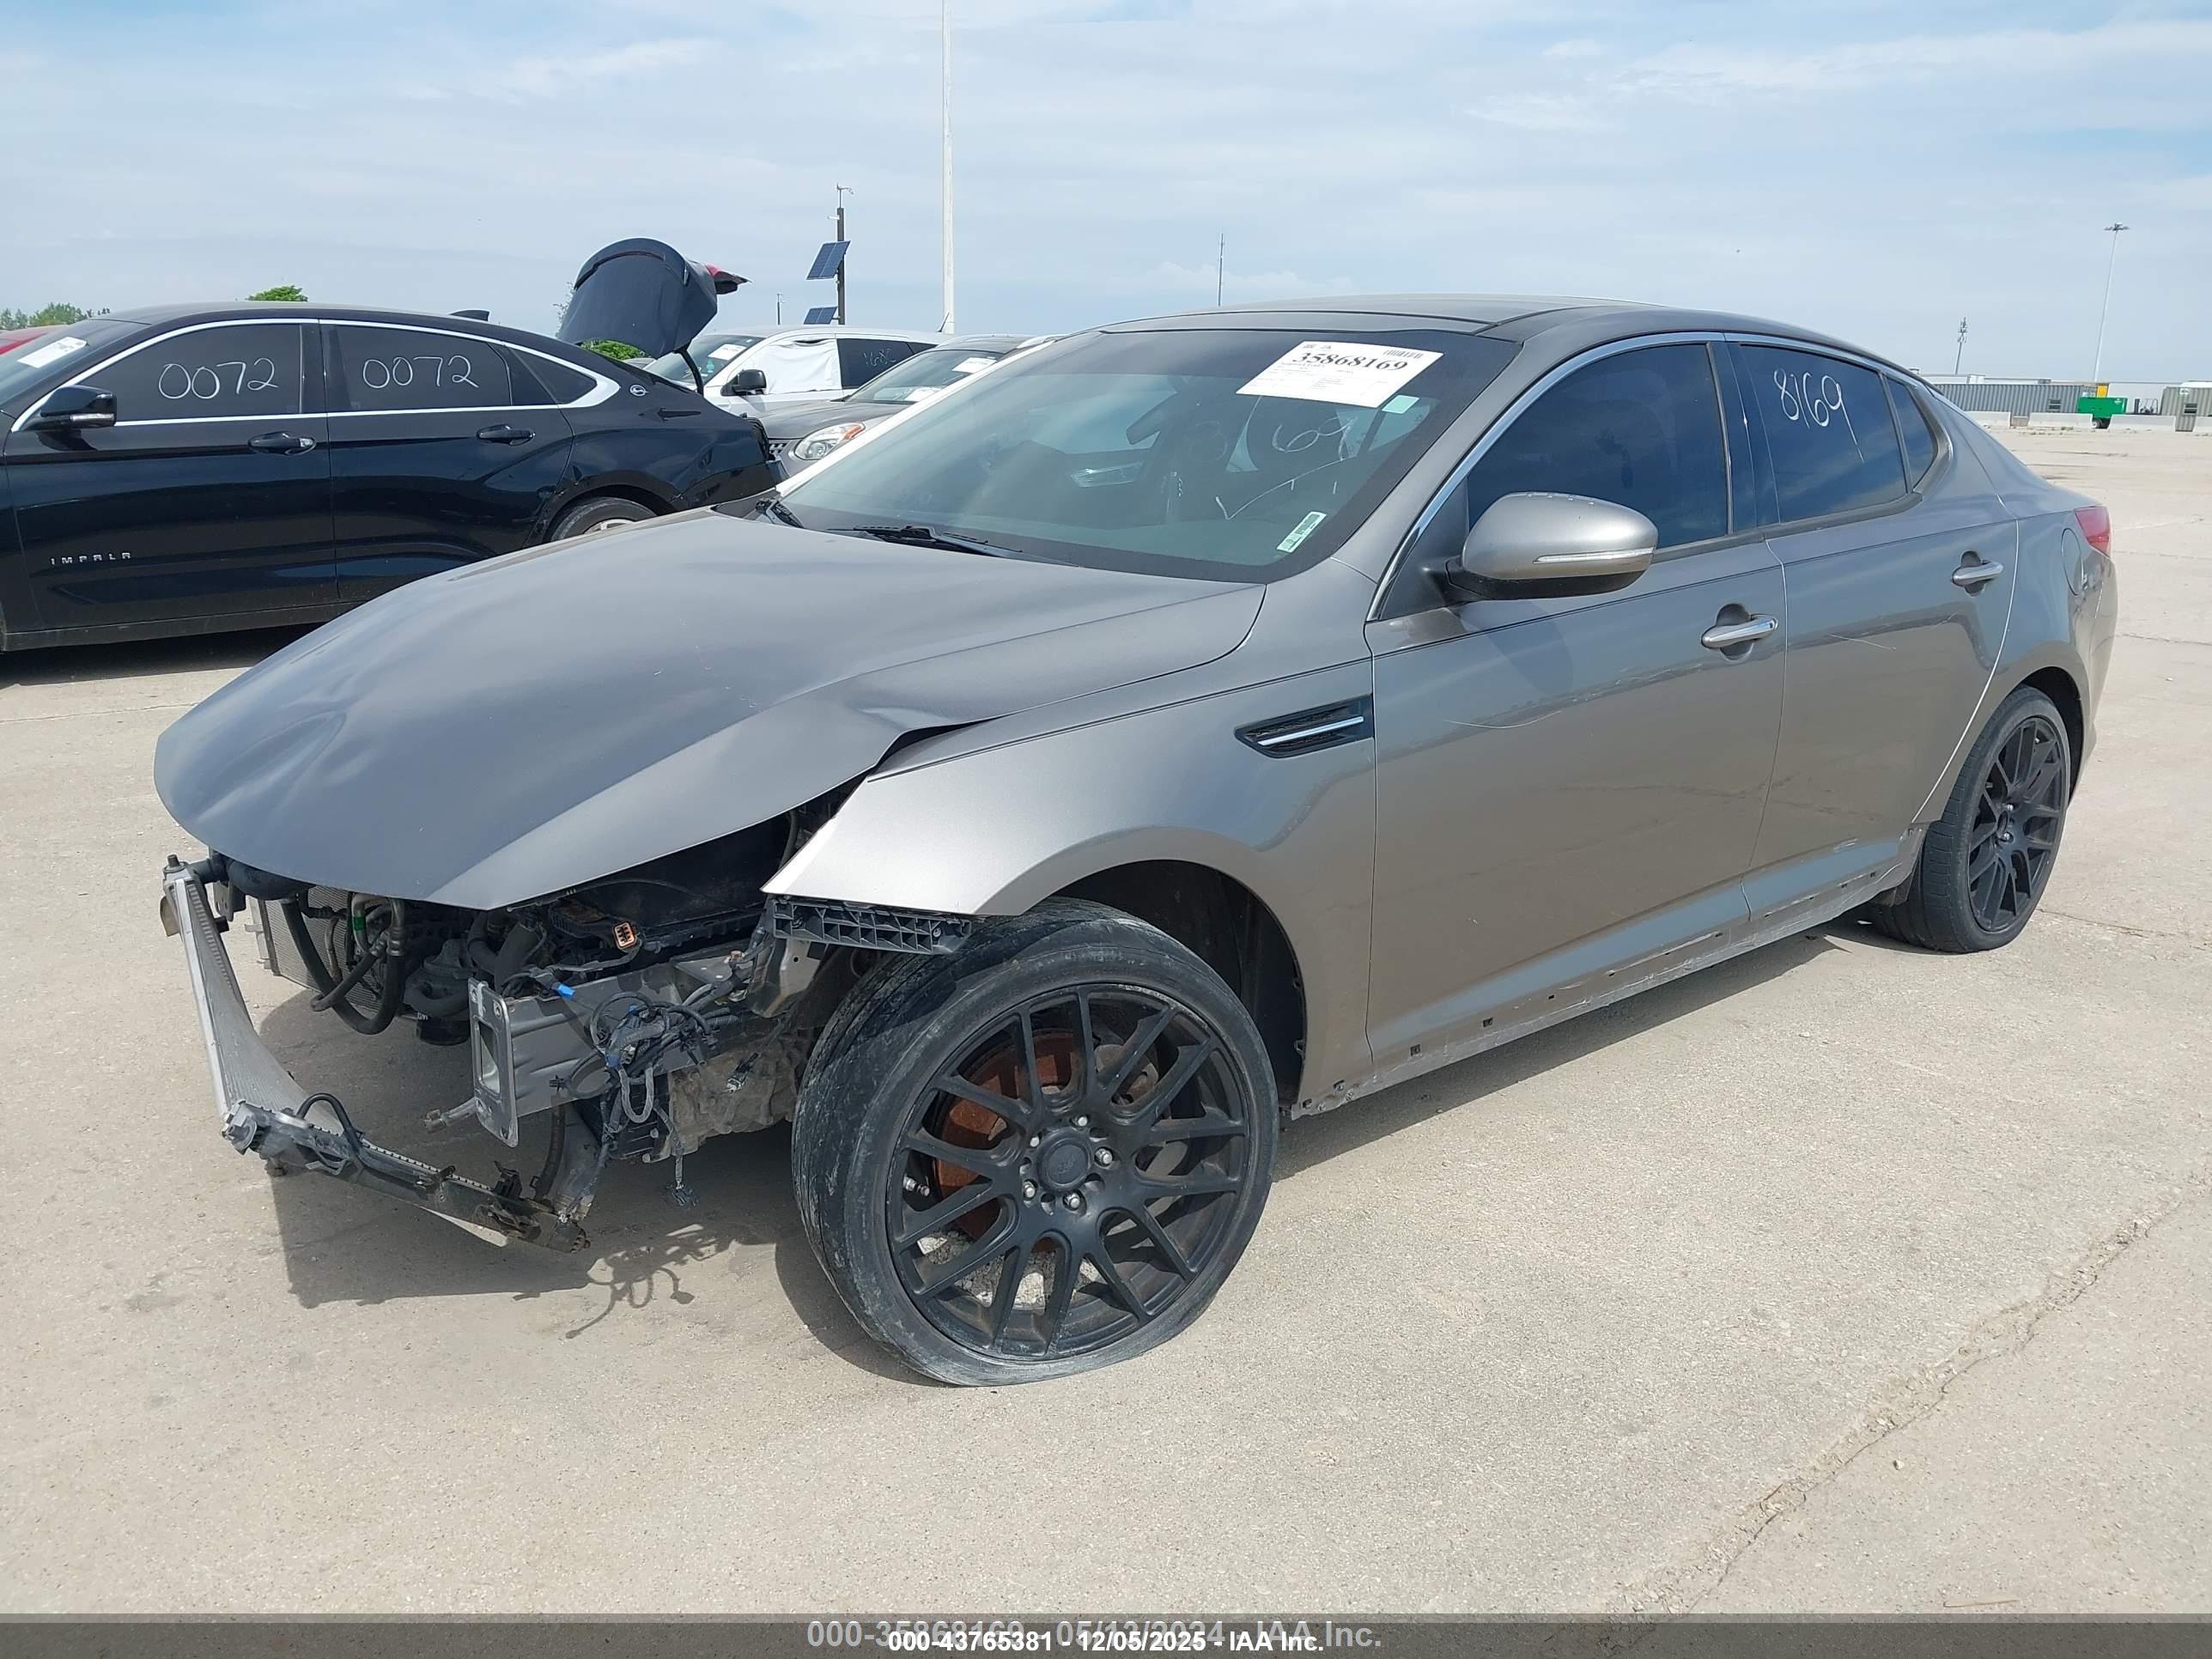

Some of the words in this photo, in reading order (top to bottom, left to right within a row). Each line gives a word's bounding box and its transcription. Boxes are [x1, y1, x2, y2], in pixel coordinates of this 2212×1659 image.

[158, 357, 278, 400] 0072
[362, 355, 480, 390] 0072
[1291, 352, 1409, 372] 35868169
[1772, 368, 1865, 462] 8169
[51, 551, 131, 565] IMPALA
